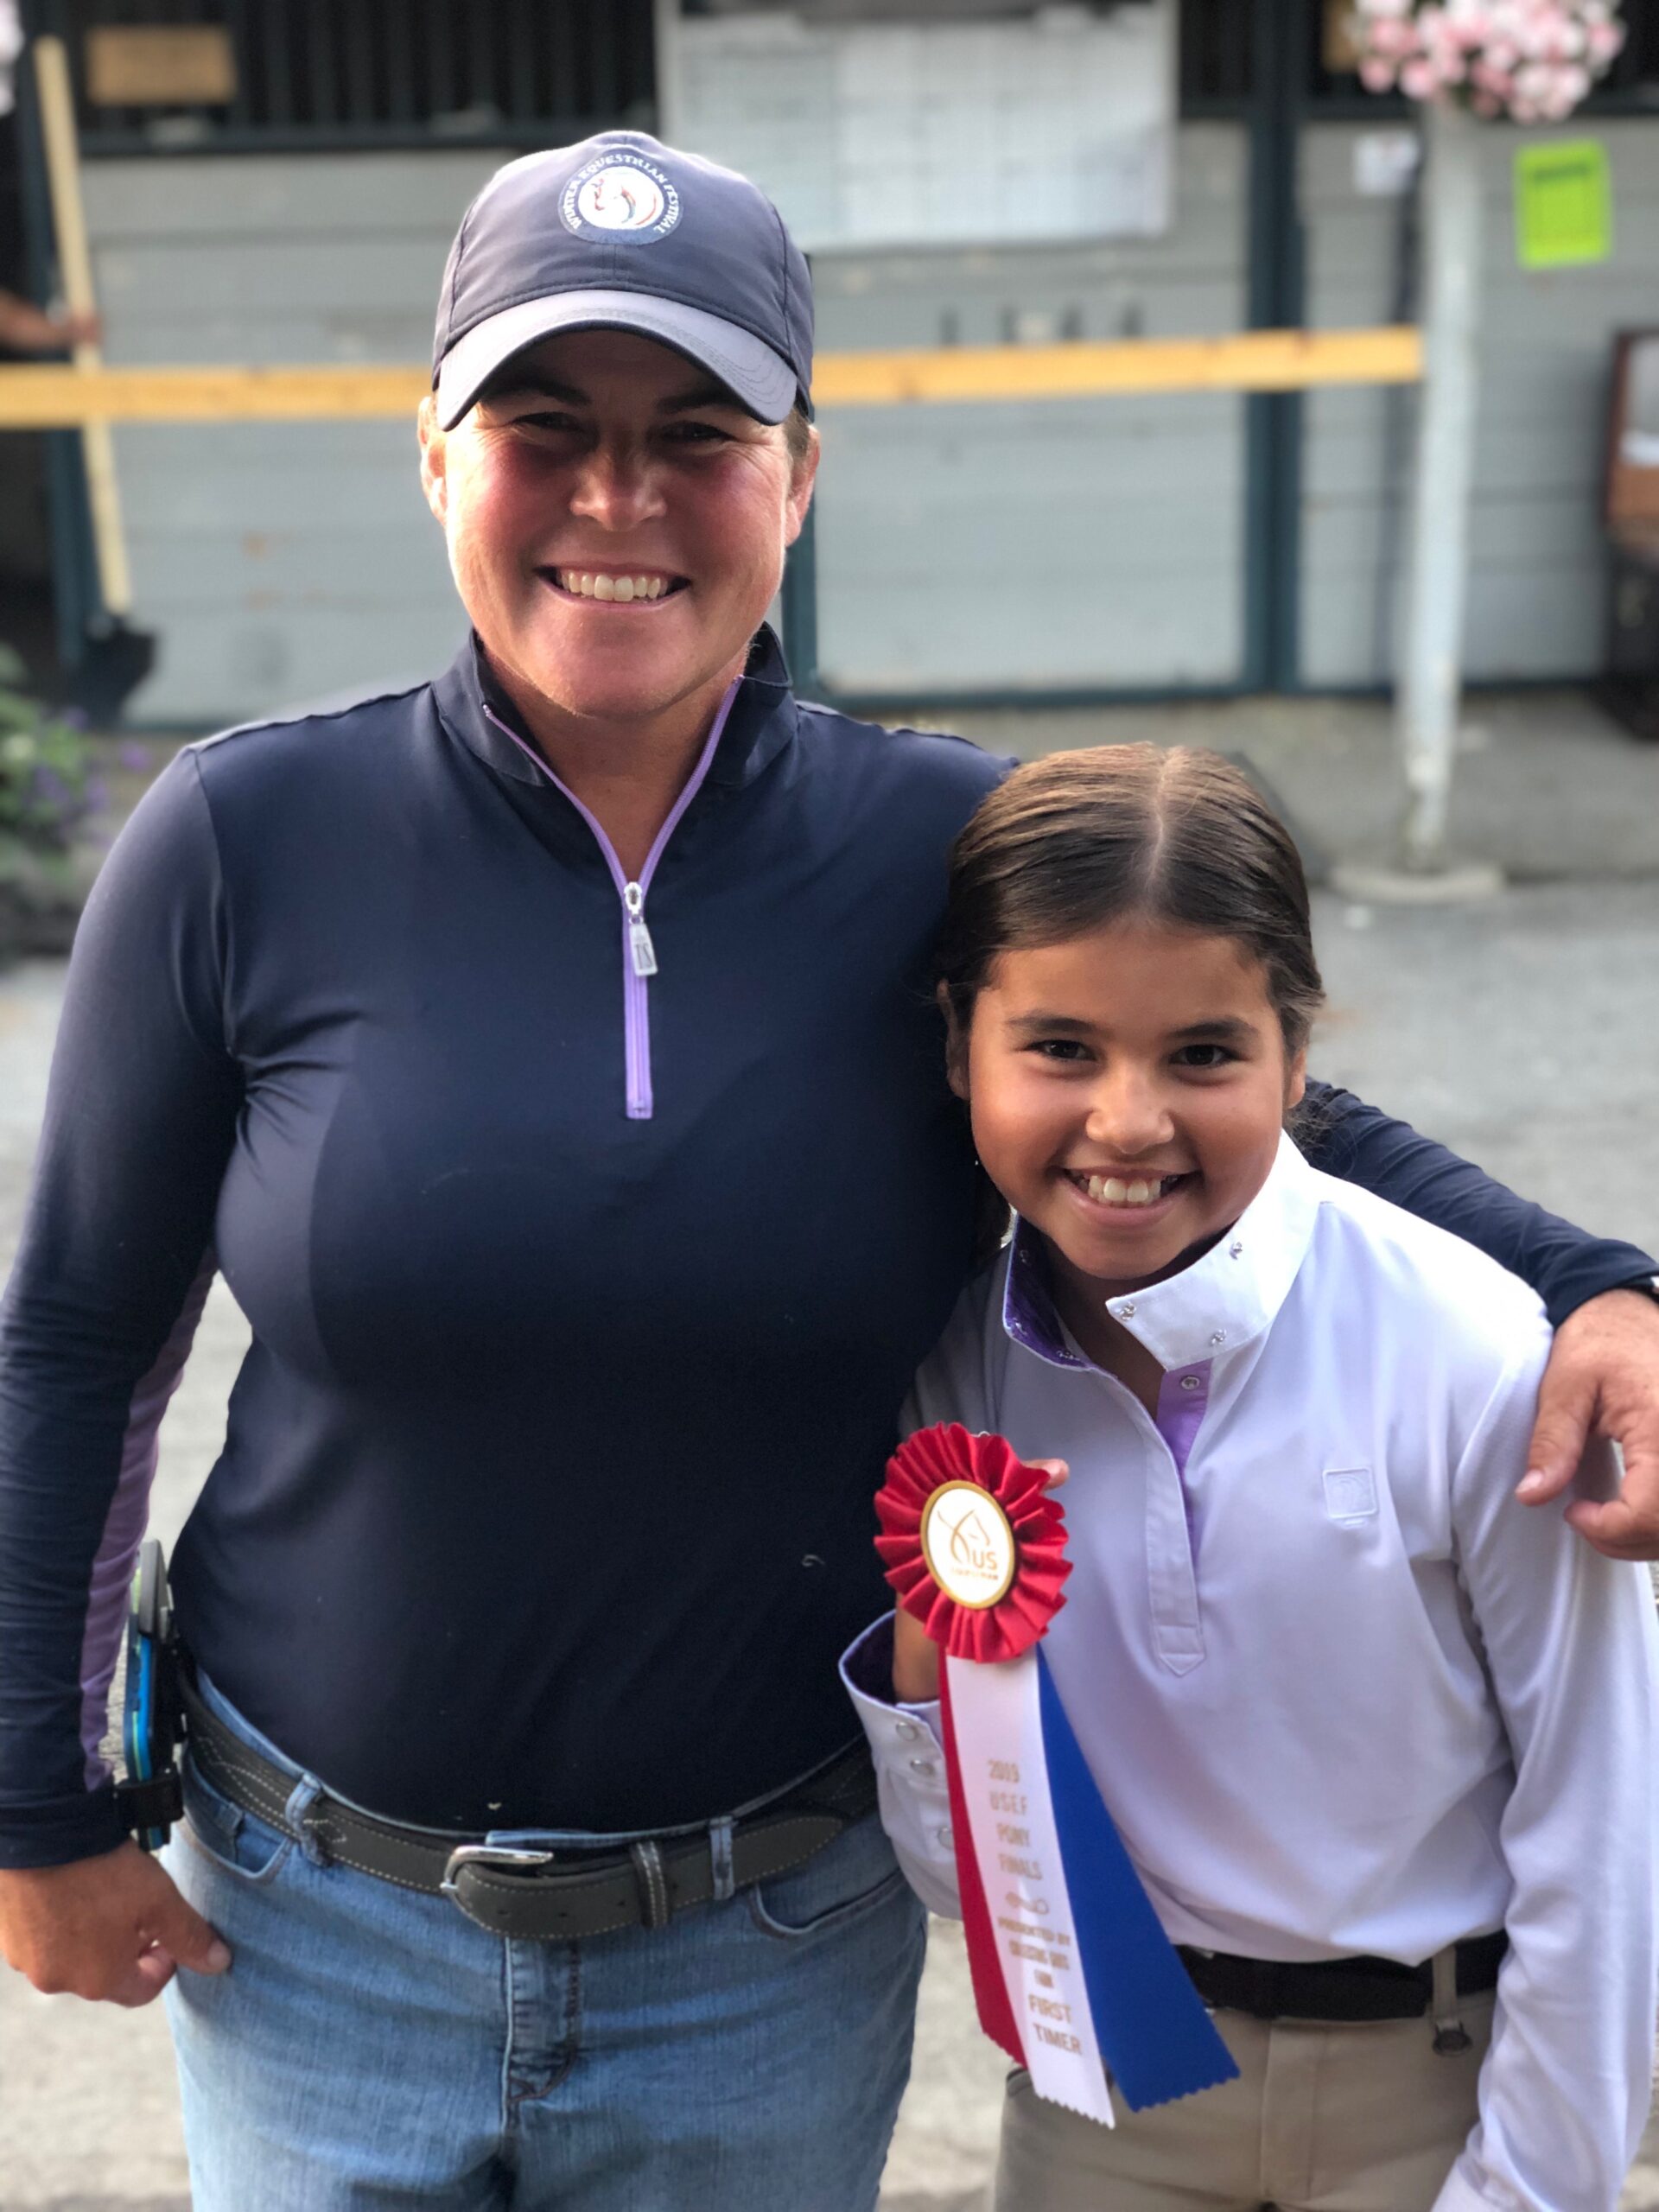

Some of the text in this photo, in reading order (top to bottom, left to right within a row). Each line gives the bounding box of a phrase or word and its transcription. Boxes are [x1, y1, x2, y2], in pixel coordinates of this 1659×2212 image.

[579, 153, 668, 185] EQUESTRIAN
[652, 183, 680, 234] FESTIVAL
[972, 1549, 998, 1571] US
[988, 1791, 1027, 1815] USEF
[996, 1822, 1031, 1847] PONY
[998, 1853, 1043, 1881] FINALS
[1028, 1993, 1071, 2024] FIRST
[1033, 2022, 1083, 2056] TIMER
